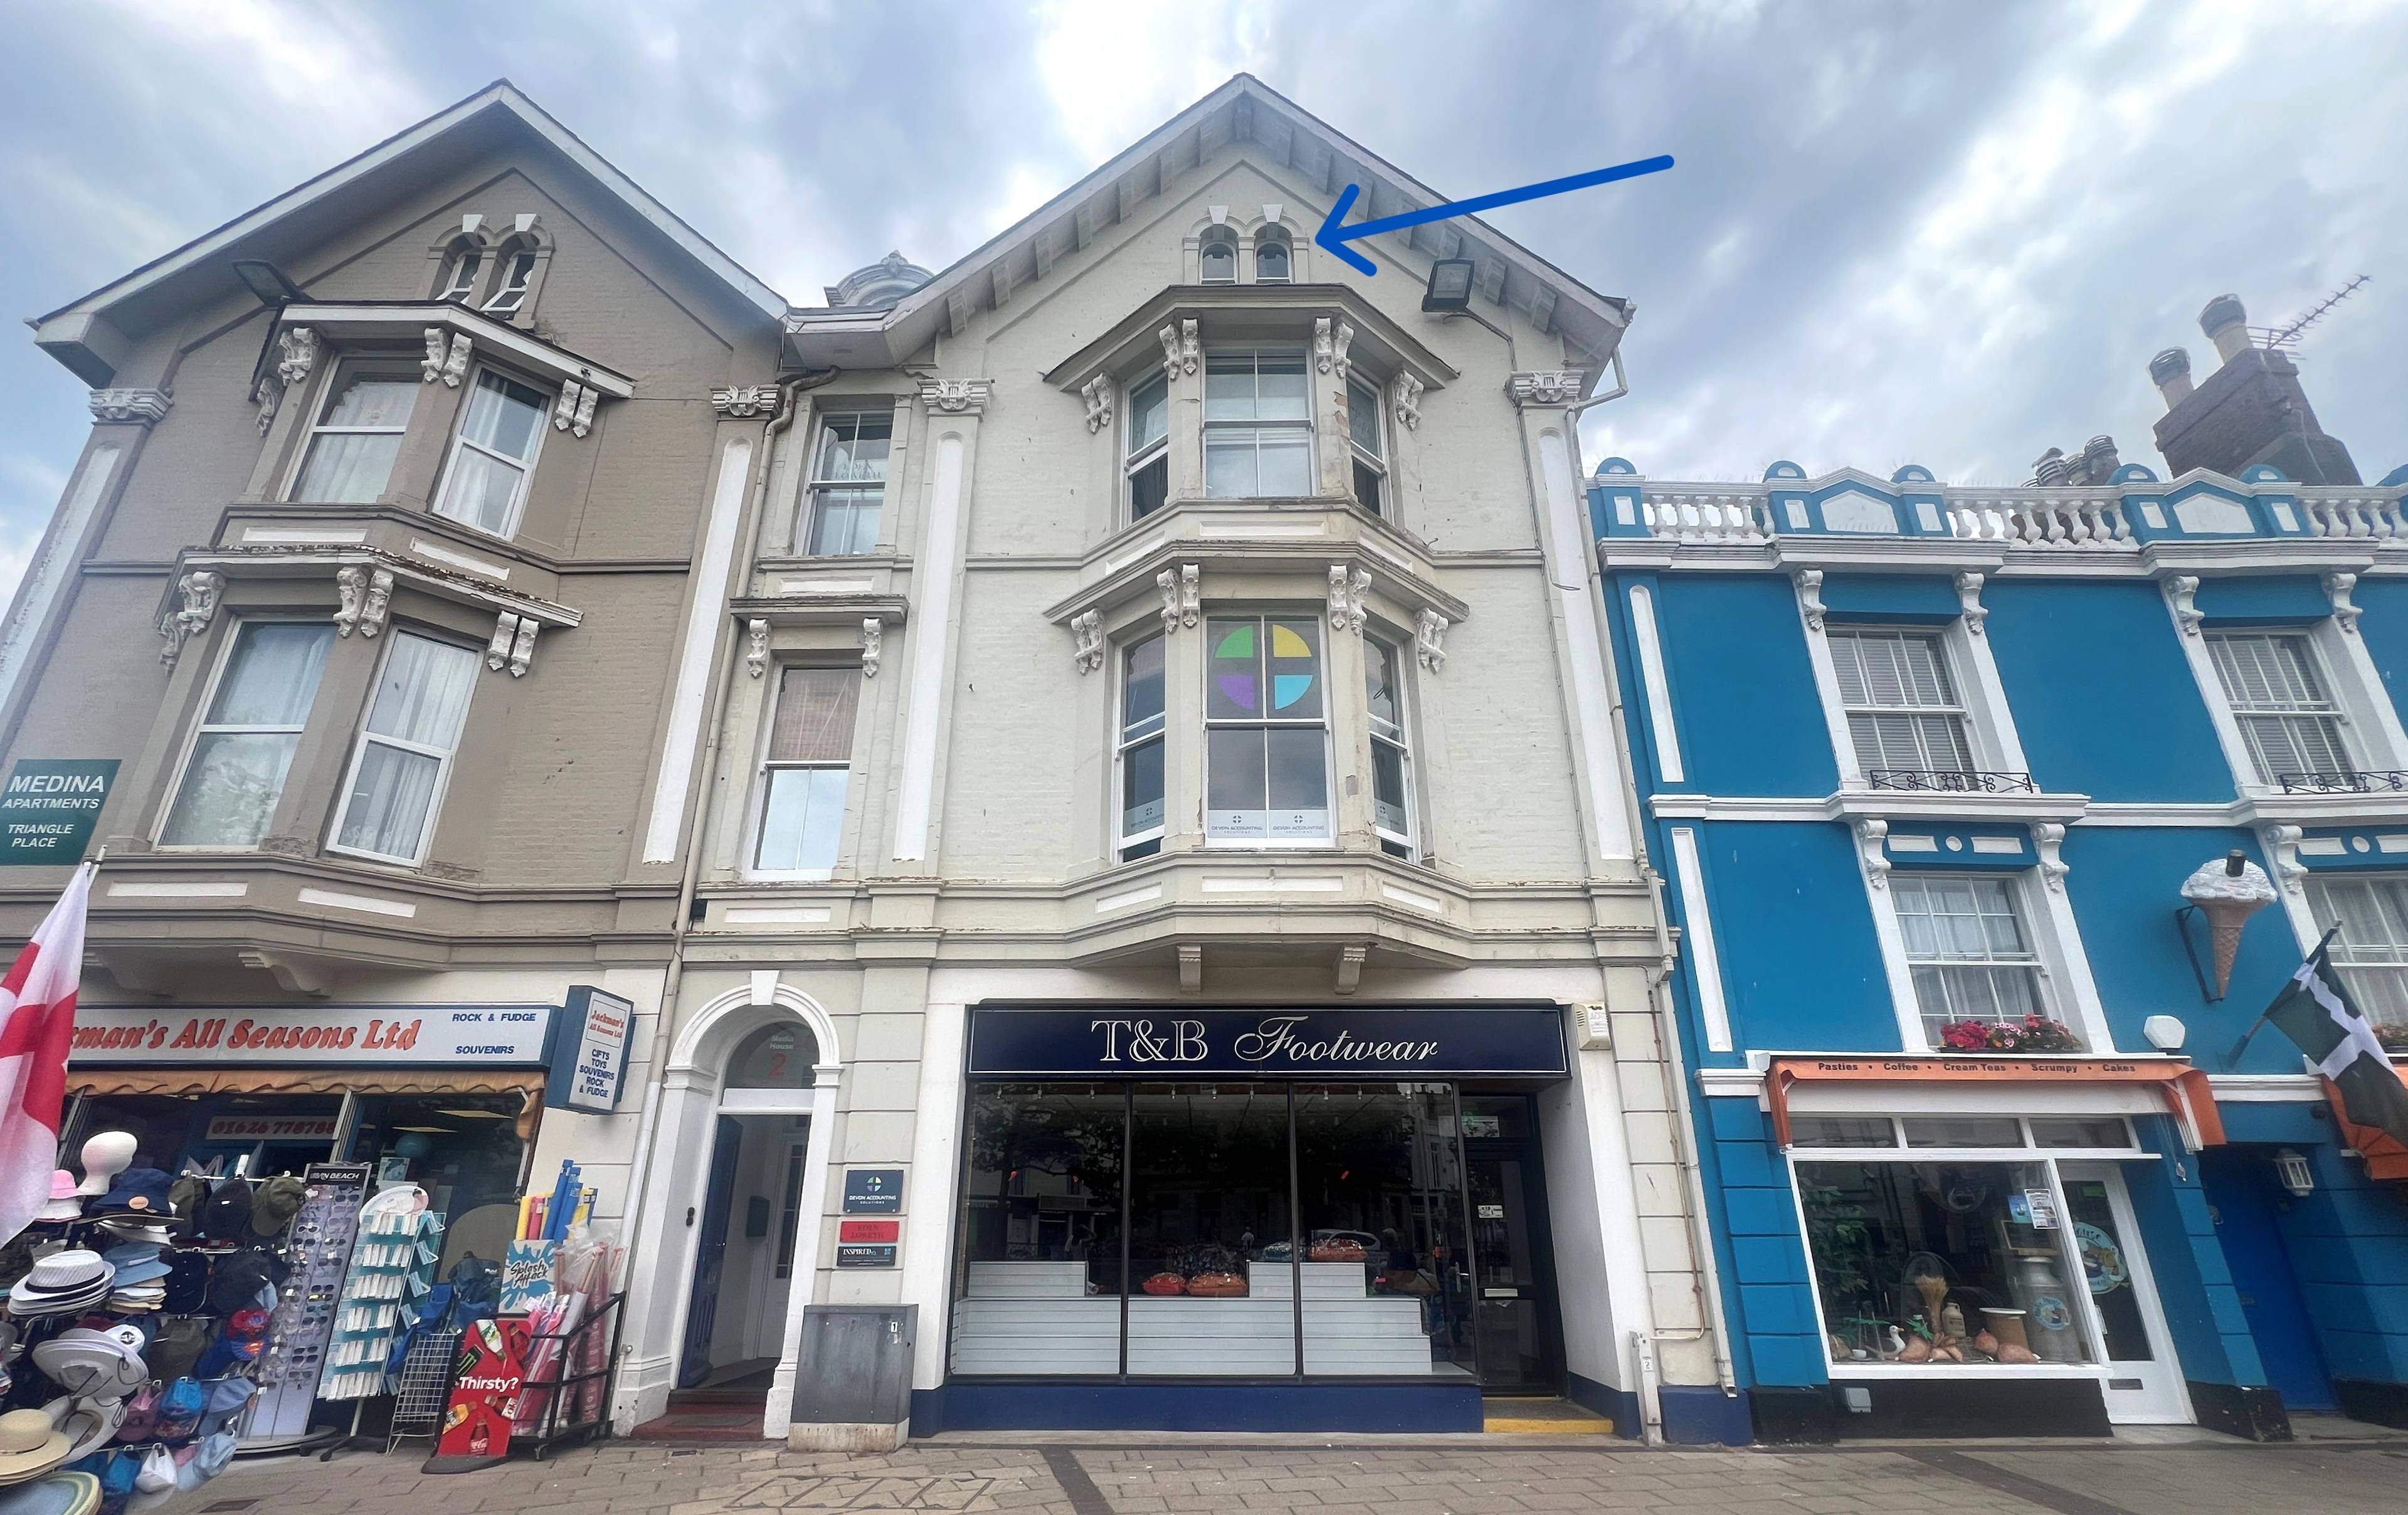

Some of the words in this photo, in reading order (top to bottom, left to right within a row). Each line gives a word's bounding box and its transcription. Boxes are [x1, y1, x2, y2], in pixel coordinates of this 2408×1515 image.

[8, 775, 105, 793] MEDINA
[1, 798, 100, 809] APARTMENTS
[8, 824, 74, 834] TRIANGLE
[11, 838, 58, 848] PLACE
[452, 1013, 482, 1022] ROCK
[487, 1013, 495, 1021] &
[501, 1013, 536, 1021] FUDGE
[170, 1018, 226, 1049] All
[227, 1018, 357, 1050] Seasons
[361, 1019, 422, 1050] Ltd
[1091, 1018, 1209, 1062] T&B
[1234, 1015, 1439, 1061] Footwear
[455, 1046, 515, 1055] SOUVENIRS
[592, 1048, 610, 1060] GIFTS
[591, 1058, 607, 1069] TOYS
[768, 1052, 787, 1077] 2
[2031, 1064, 2078, 1074] Scrumpy
[579, 1065, 615, 1080] SOUVENIRS
[586, 1076, 604, 1087] ROCK
[579, 1085, 584, 1093] &
[587, 1087, 608, 1097] FUDGE
[510, 1260, 544, 1277] Splash
[514, 1266, 547, 1287] Attack
[892, 1322, 896, 1331] 1
[459, 1376, 519, 1392] Thirsty?
